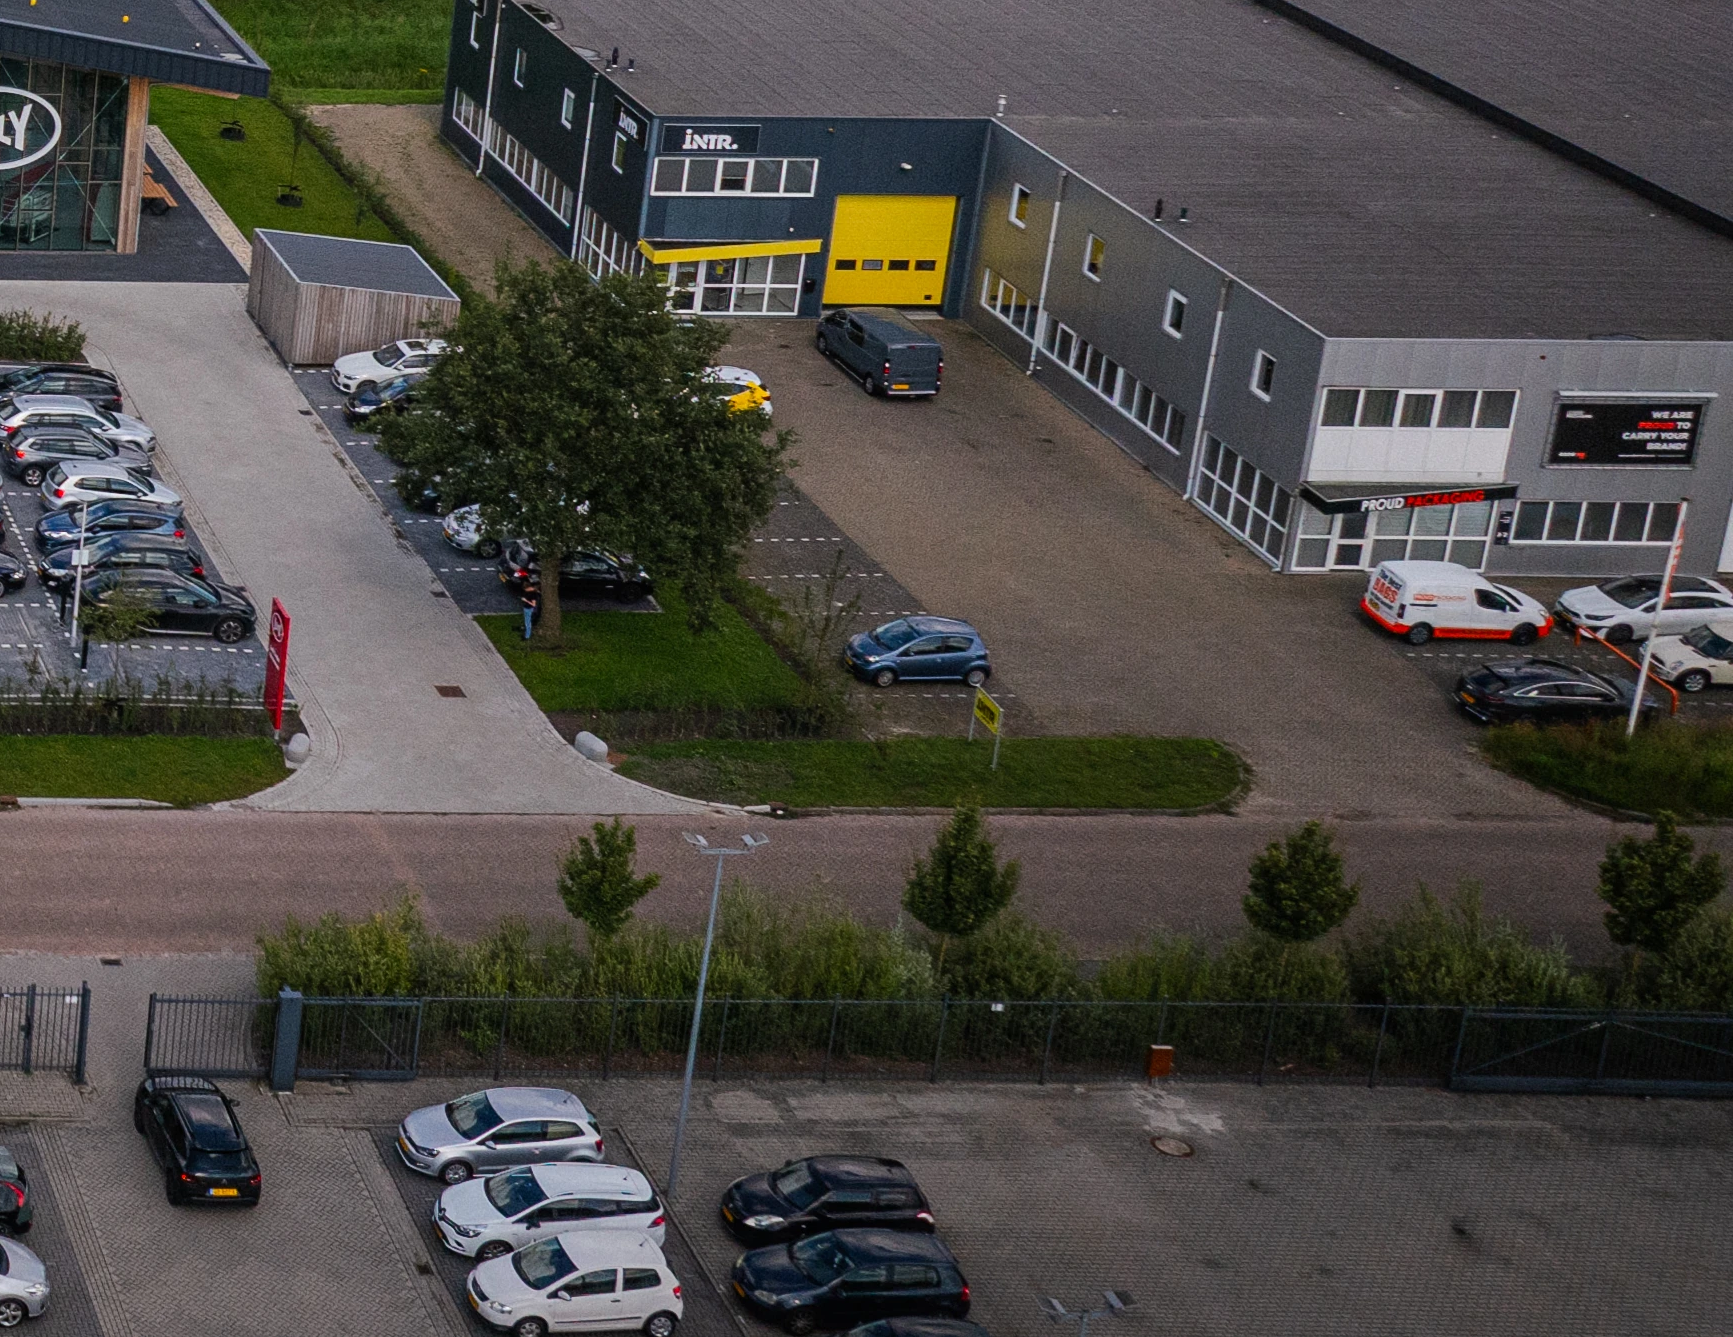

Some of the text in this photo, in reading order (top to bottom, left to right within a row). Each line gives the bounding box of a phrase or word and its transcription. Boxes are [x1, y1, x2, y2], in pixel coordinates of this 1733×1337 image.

[1651, 411, 1694, 419] WE ARE
[1676, 421, 1691, 429] TO
[1622, 432, 1690, 440] CARRY YOUR
[1361, 490, 1485, 512] PROUD PACKAGING
